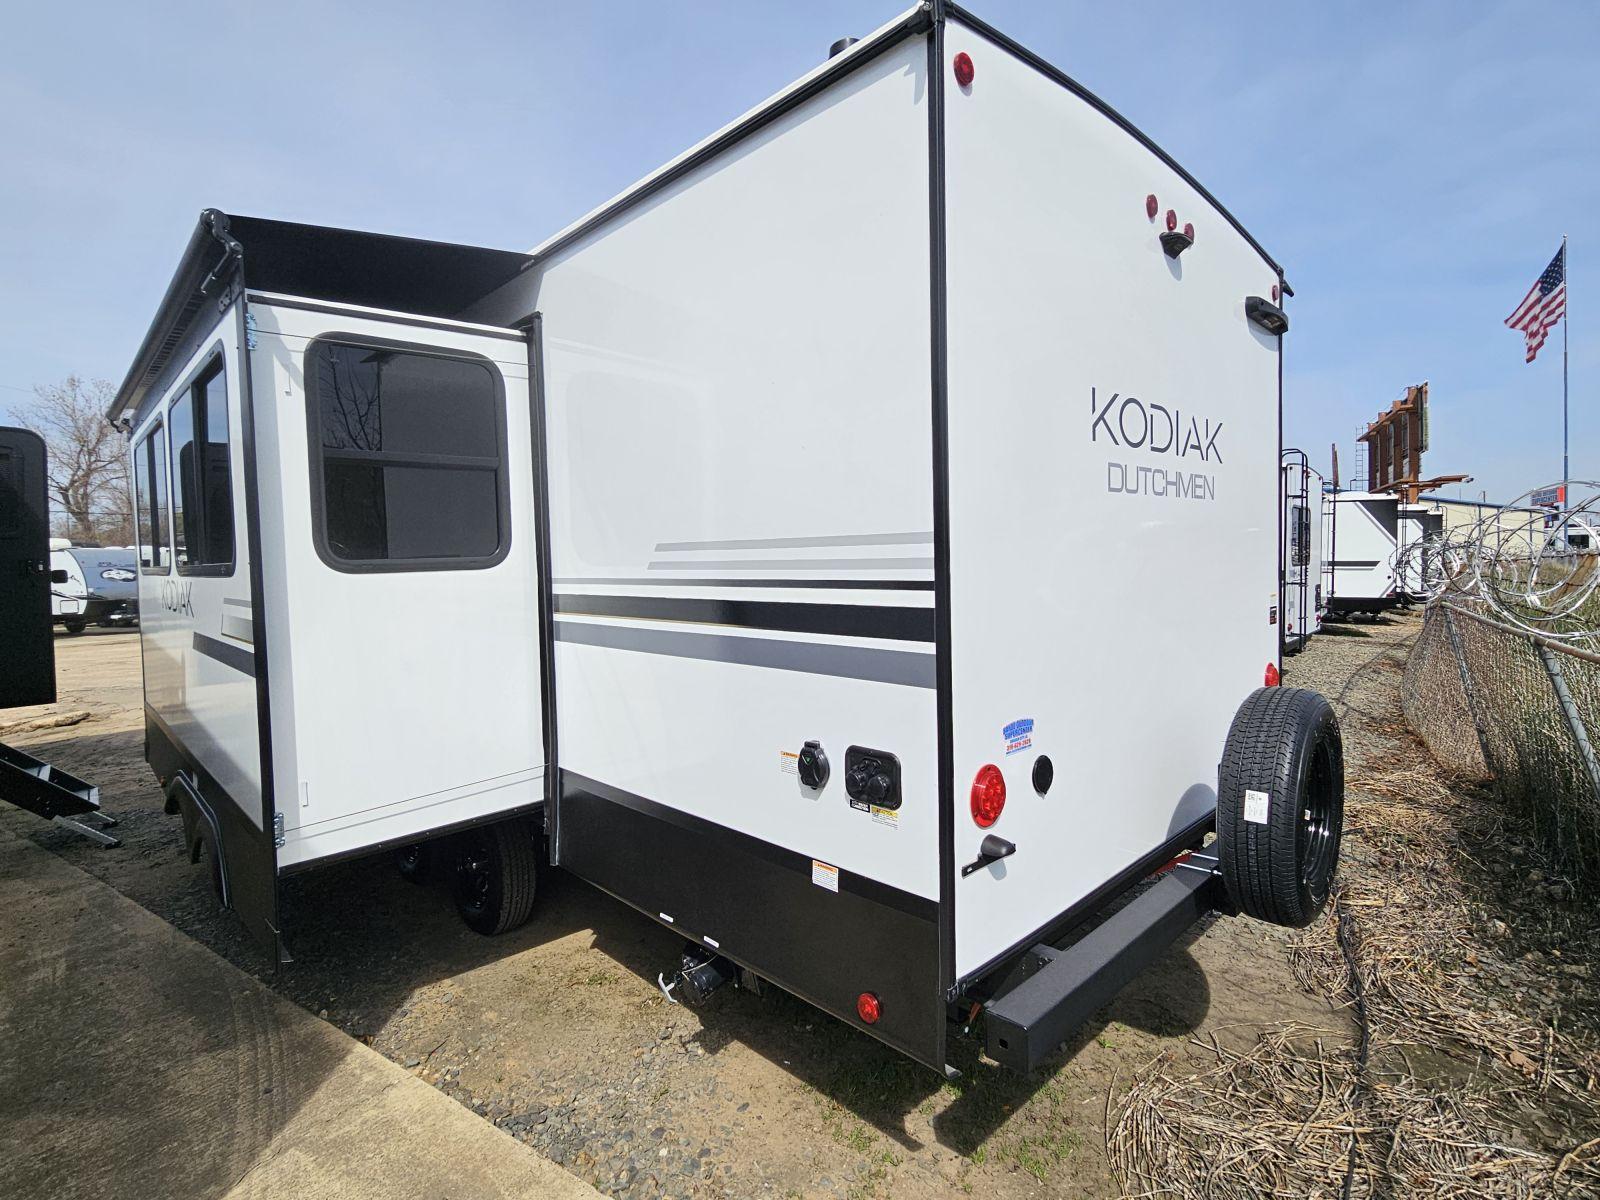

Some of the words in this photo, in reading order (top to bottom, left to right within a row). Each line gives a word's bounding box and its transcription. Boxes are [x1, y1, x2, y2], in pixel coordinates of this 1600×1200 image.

[1091, 386, 1223, 464] KODIAK
[1107, 462, 1215, 500] DUTCHMEN
[162, 579, 194, 618] KODIAK
